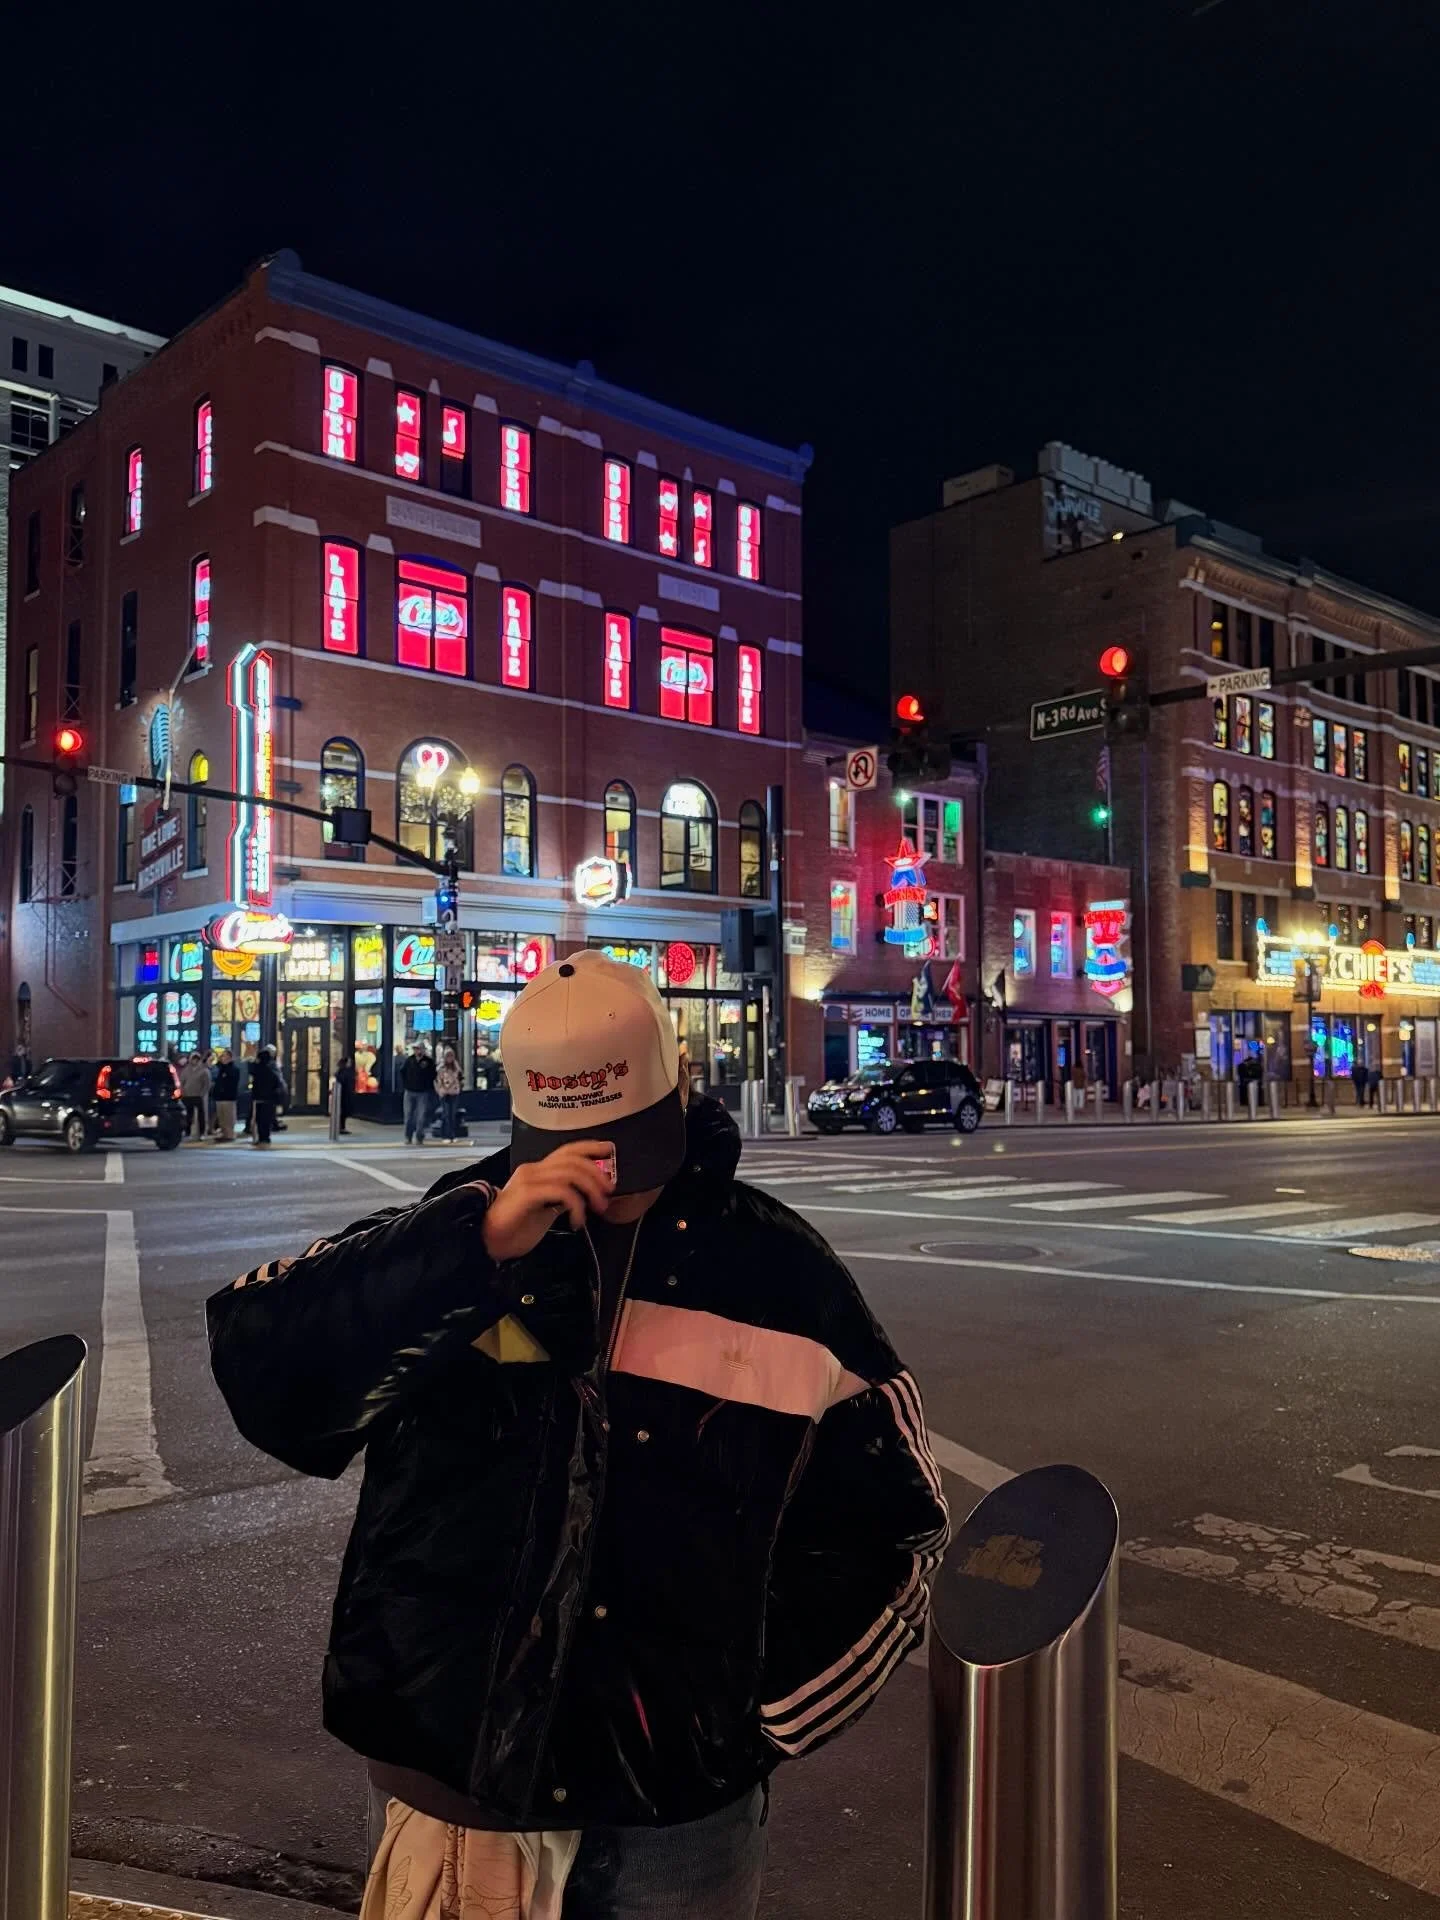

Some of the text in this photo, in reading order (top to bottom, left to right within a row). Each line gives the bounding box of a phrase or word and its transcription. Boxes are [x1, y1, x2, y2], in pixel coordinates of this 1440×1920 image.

[328, 370, 346, 458] OPEN
[504, 429, 521, 511] OPEN
[607, 464, 622, 542] OPEN
[739, 506, 752, 578] OPEN
[329, 554, 346, 641] LATE
[507, 597, 522, 678] LATE
[609, 622, 623, 698] LATE
[741, 654, 754, 724] LATE
[1219, 671, 1269, 692] PARKING
[1077, 707, 1098, 722] Ave
[88, 767, 128, 784] PARKING
[288, 959, 331, 976] LOVE
[1337, 952, 1412, 984] CHIEFS
[865, 1008, 892, 1018] HOME
[525, 1060, 629, 1092] Posty's
[561, 1090, 604, 1102] BROADWAY
[581, 1092, 623, 1108] TENNESSEE
